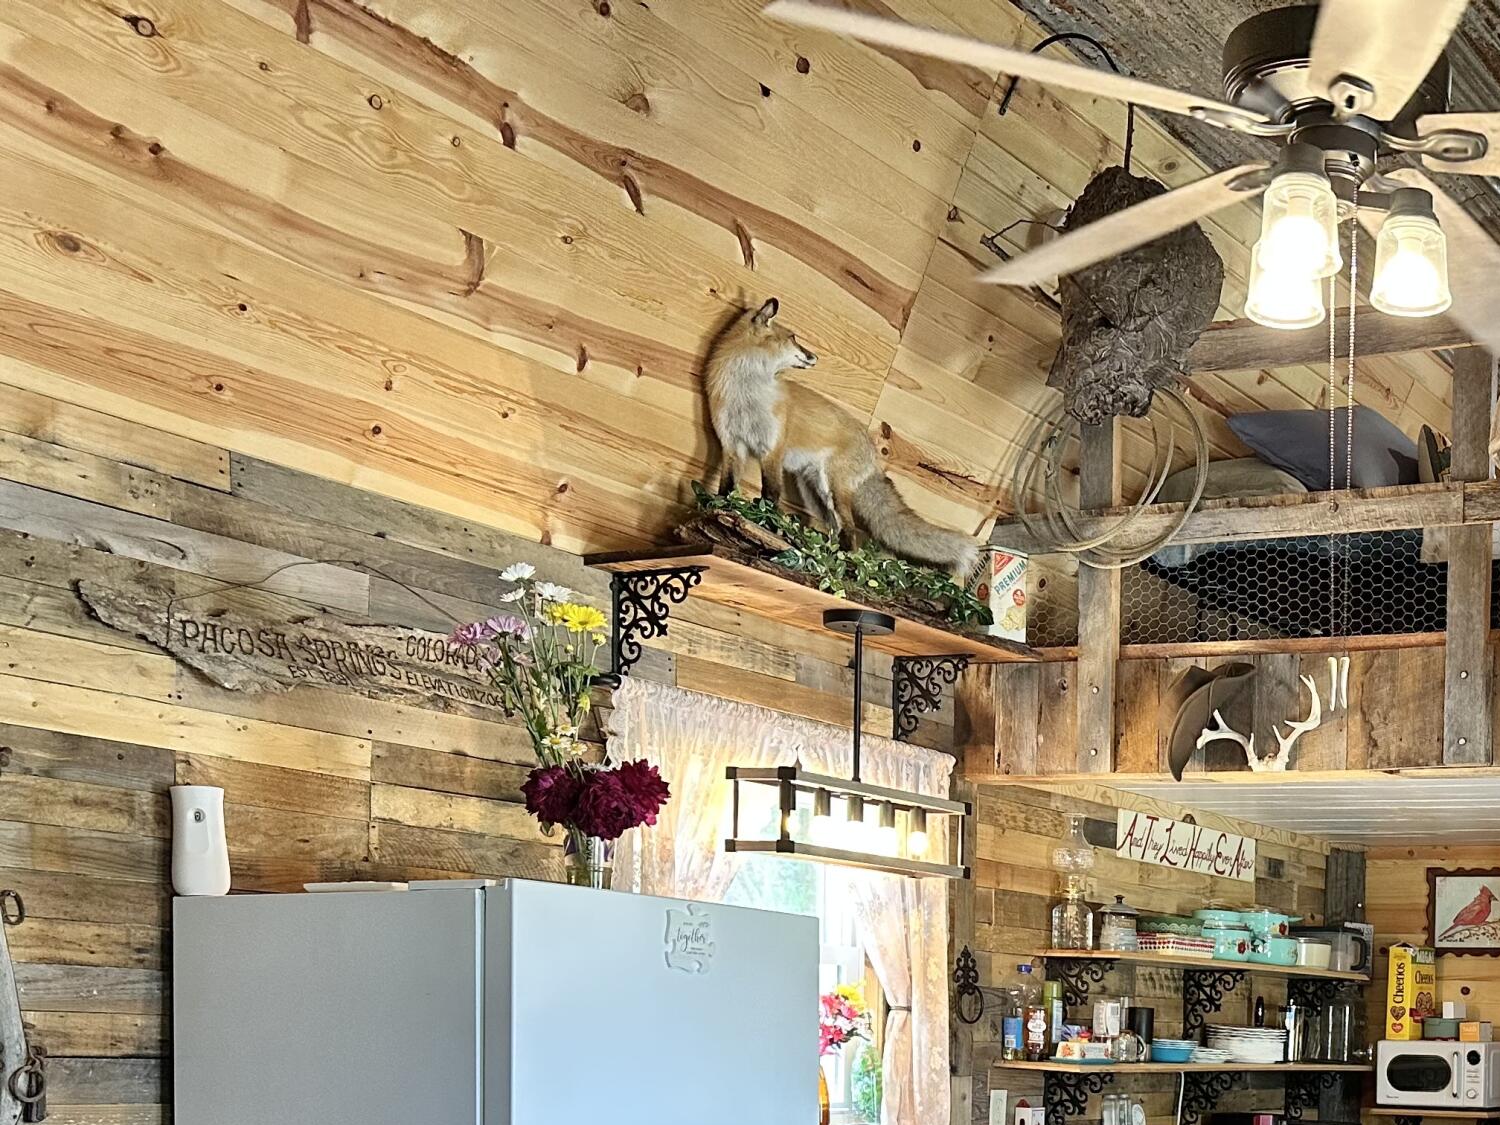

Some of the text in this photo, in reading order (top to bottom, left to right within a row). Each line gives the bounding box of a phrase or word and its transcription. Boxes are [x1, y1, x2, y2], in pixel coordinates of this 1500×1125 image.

[994, 560, 1026, 595] PREMIUM
[180, 619, 402, 682] PAGOSA SPRINGS
[406, 671, 480, 700] ELEVATION
[1117, 813, 1254, 878] And They Lived Happily Ever After
[1393, 962, 1406, 1004] Cheerios
